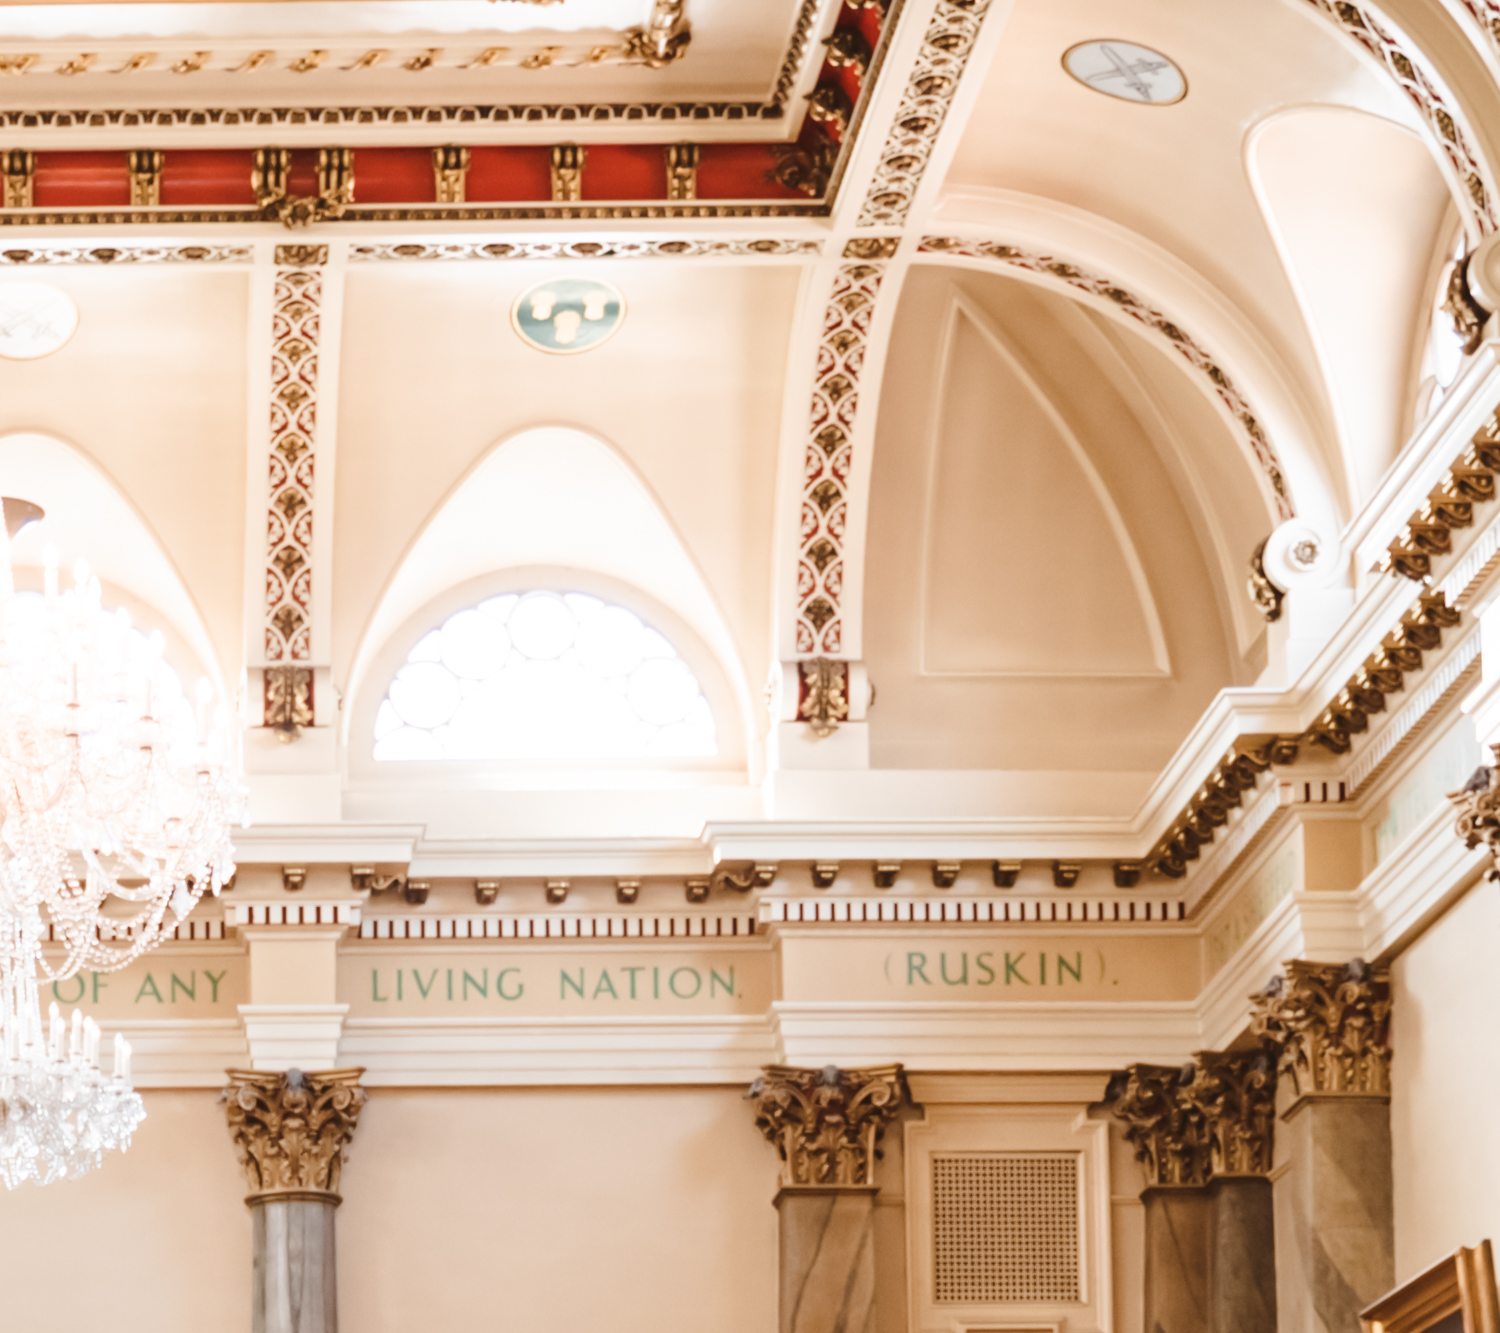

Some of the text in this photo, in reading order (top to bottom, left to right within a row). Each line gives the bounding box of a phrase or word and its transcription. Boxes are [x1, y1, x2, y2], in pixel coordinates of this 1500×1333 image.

[51, 969, 109, 1004] OF
[134, 969, 227, 1004] ANY
[371, 967, 525, 1002] LIVING
